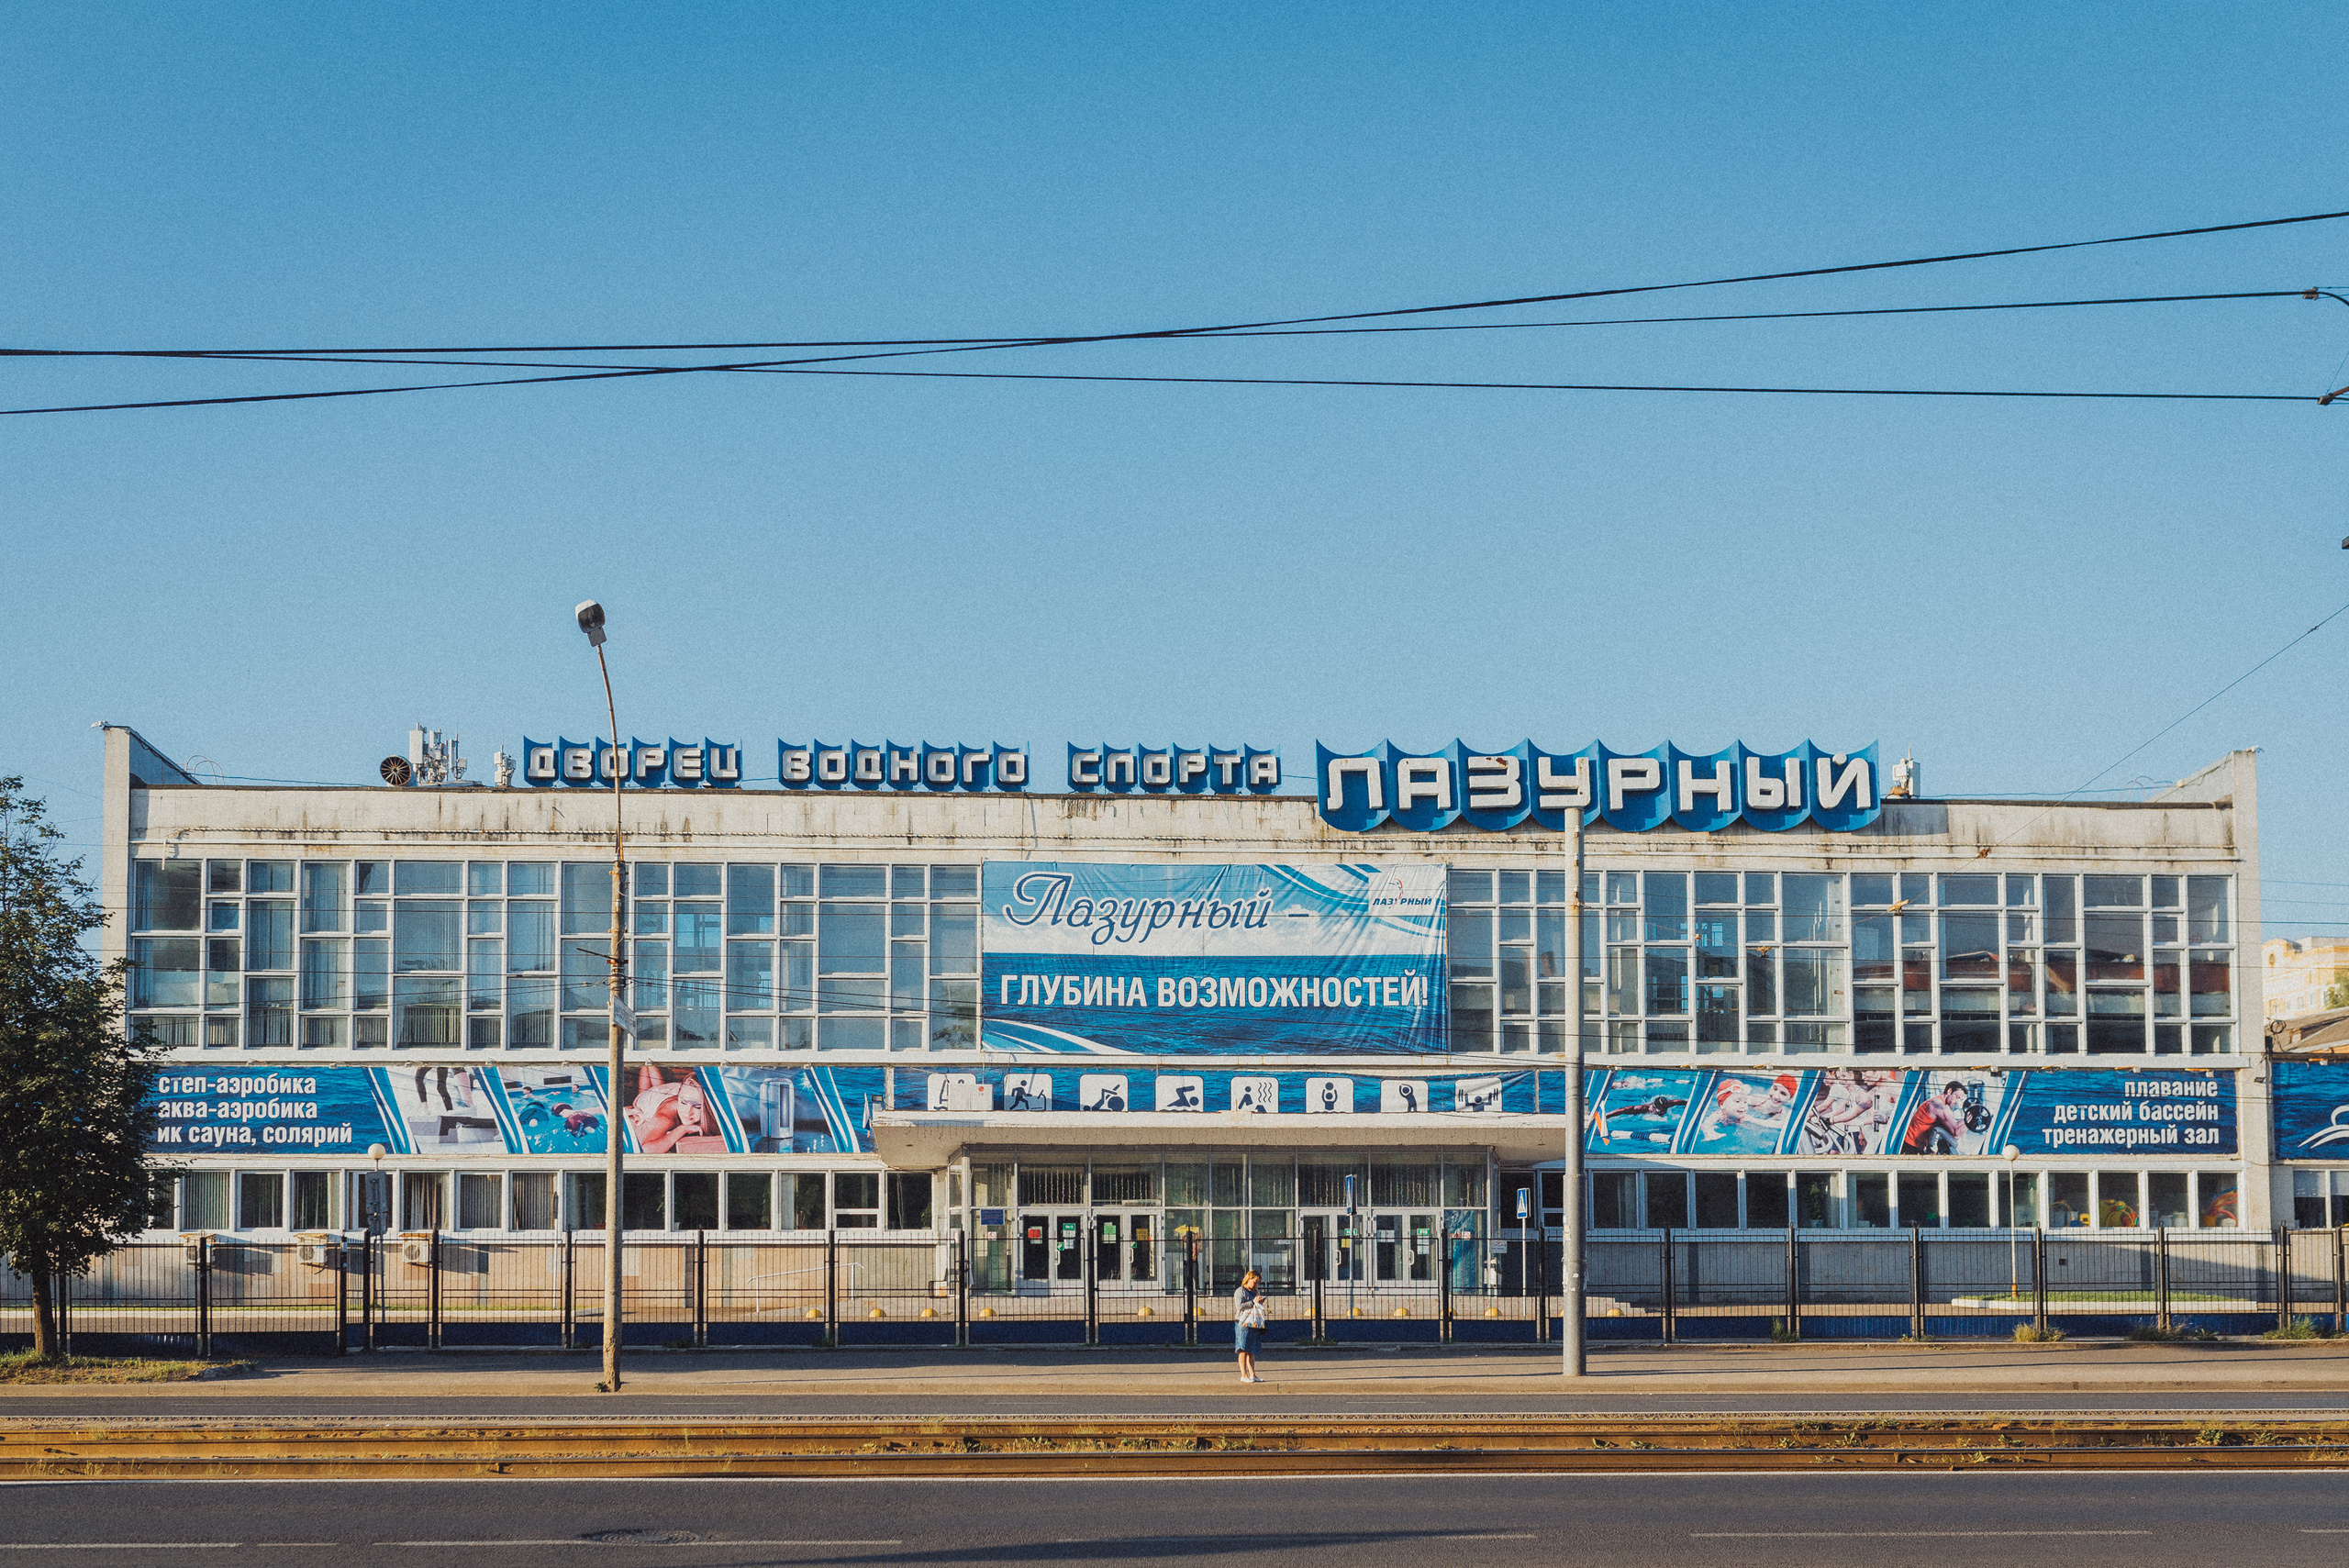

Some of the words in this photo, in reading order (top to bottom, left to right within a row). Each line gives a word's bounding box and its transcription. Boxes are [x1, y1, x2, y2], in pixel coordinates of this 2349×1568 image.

[528, 746, 740, 782] ДВОРЕЦ
[782, 750, 1027, 783] ВОДНОГО
[1071, 751, 1279, 785] СПОРТА
[1327, 752, 1872, 812] ЛАЗУРНЫЙ
[1004, 871, 1273, 946] Лазурный
[1000, 974, 1148, 1007] ГЛУБИНА
[1156, 969, 1430, 1008] ВОЗМОЖНОСТЕЙ!
[158, 1073, 317, 1098] степ-аэробика
[2124, 1081, 2218, 1097] плавание
[158, 1098, 317, 1123] аква-аэробика
[2053, 1101, 2132, 1124] детский
[2138, 1100, 2219, 1120] бассейн
[157, 1126, 183, 1143] ик
[188, 1126, 257, 1147] сауна,
[262, 1122, 352, 1147] солярий
[2042, 1124, 2178, 1148] тренажерный
[2184, 1128, 2220, 1145] зал
